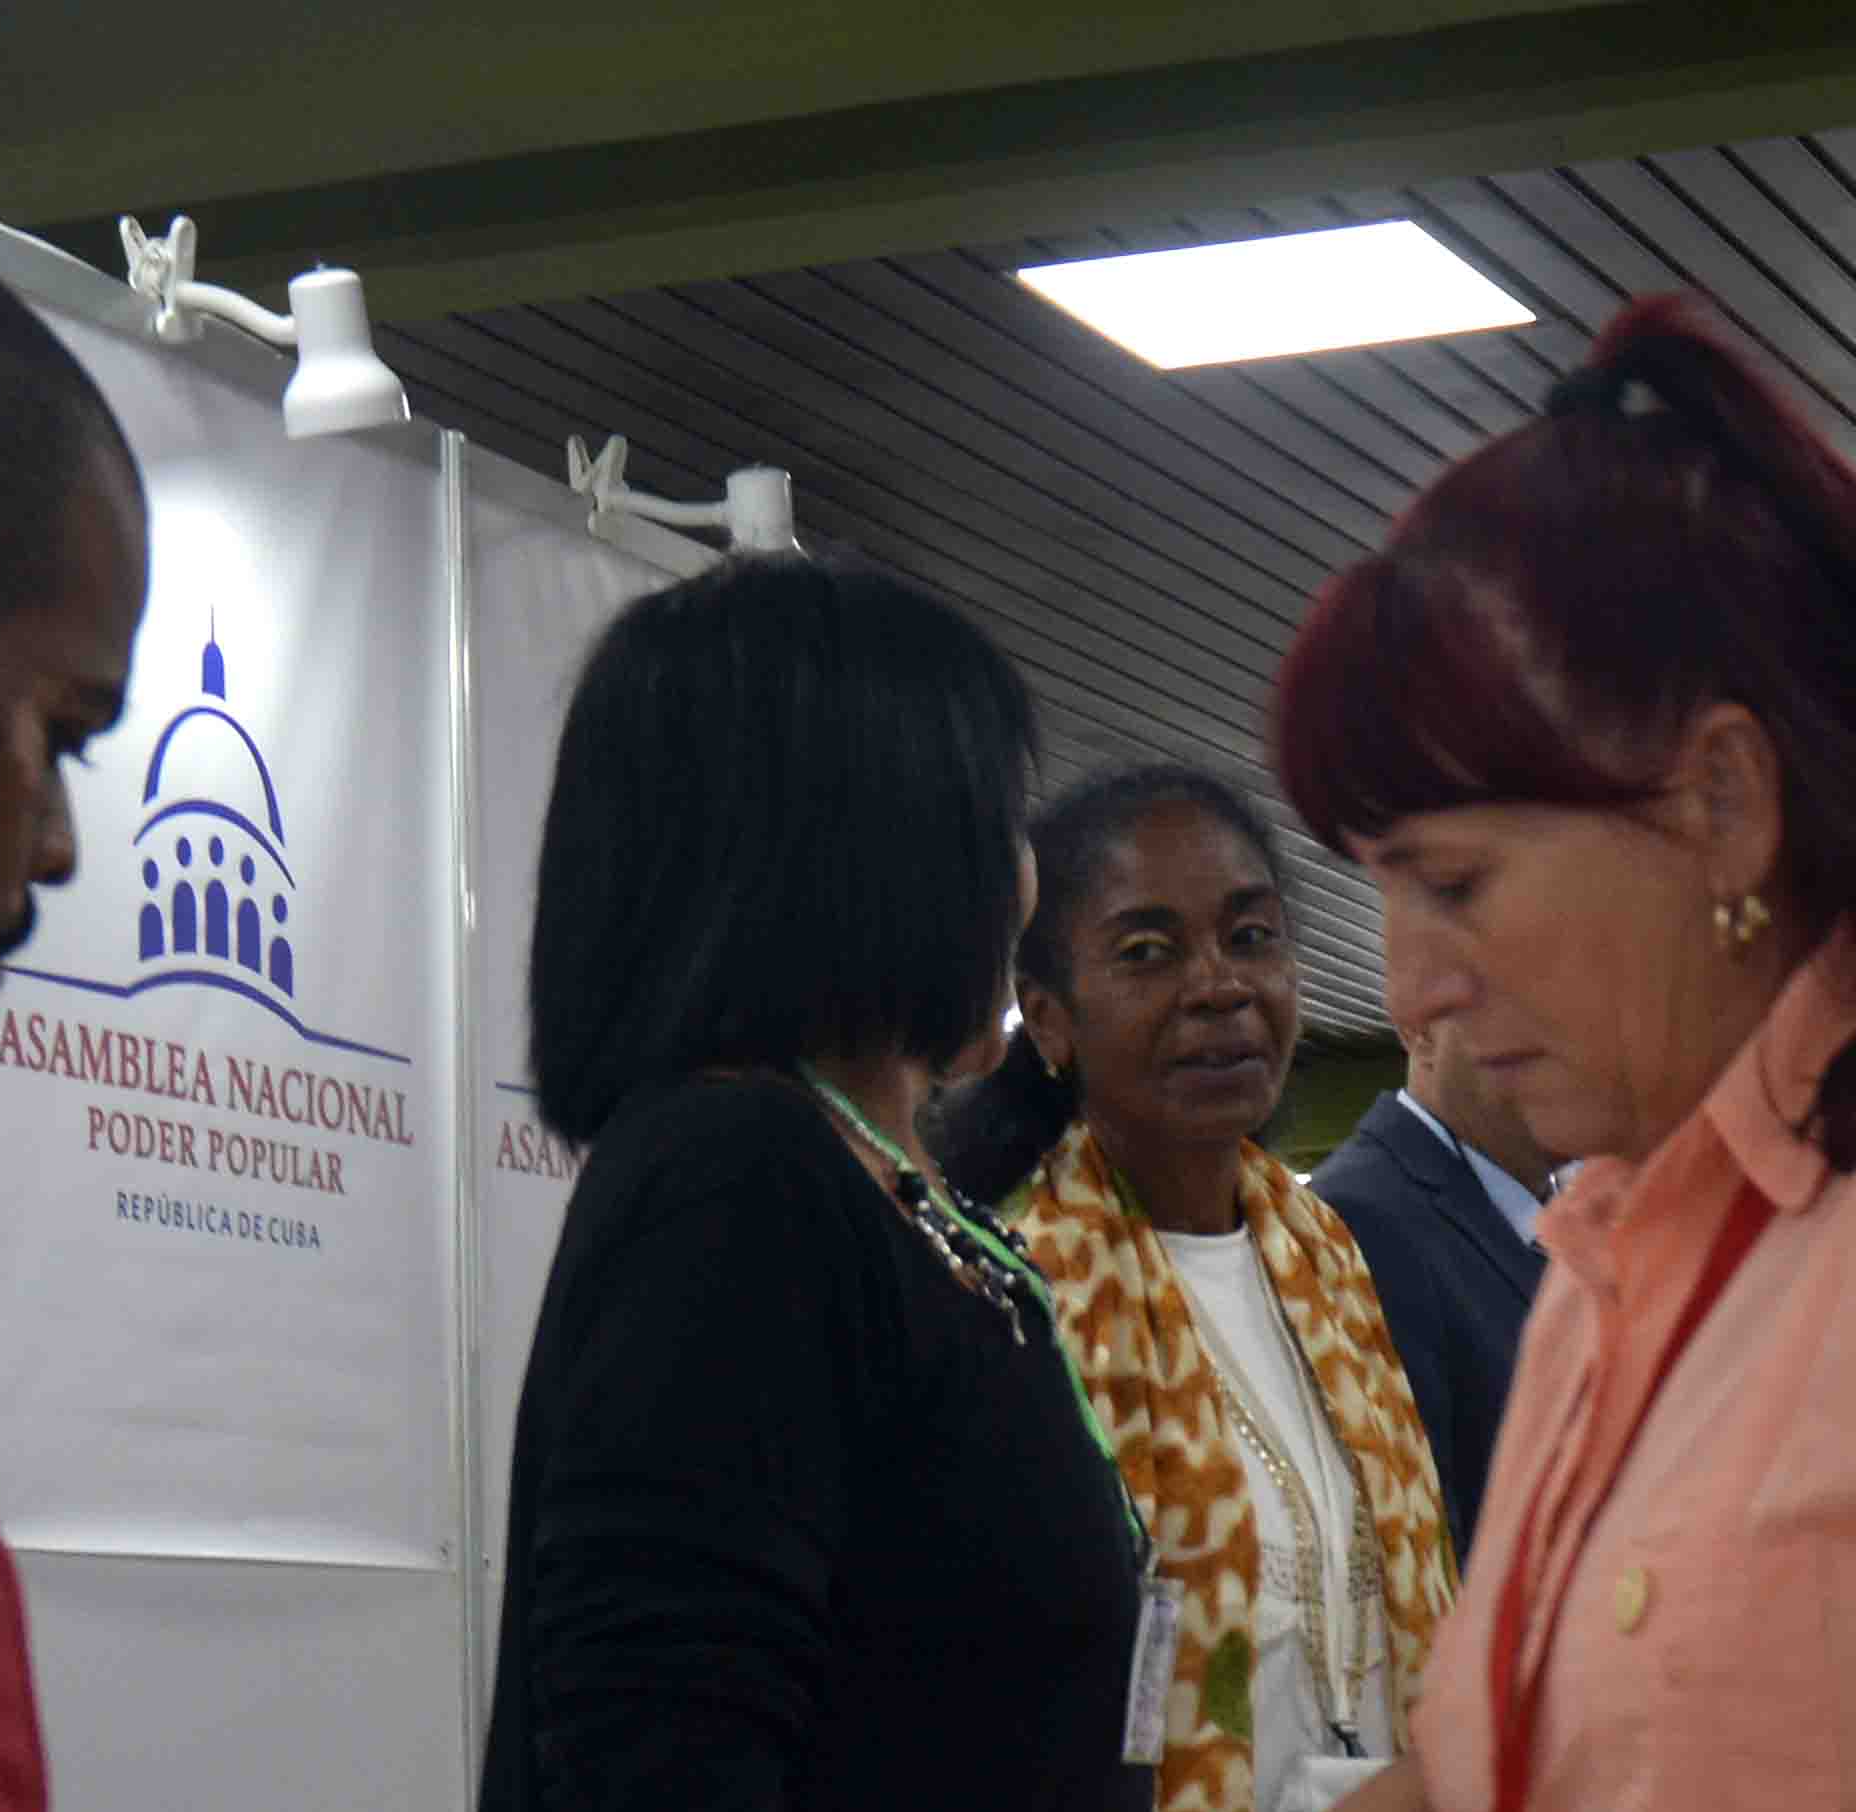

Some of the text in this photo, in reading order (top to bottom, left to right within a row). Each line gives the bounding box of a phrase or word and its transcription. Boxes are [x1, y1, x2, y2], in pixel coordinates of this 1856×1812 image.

[225, 1055, 414, 1145] NACIONAL
[87, 1104, 347, 1195] PODER POPULAR
[116, 1189, 321, 1249] REPÚBLICA DE CUBA
